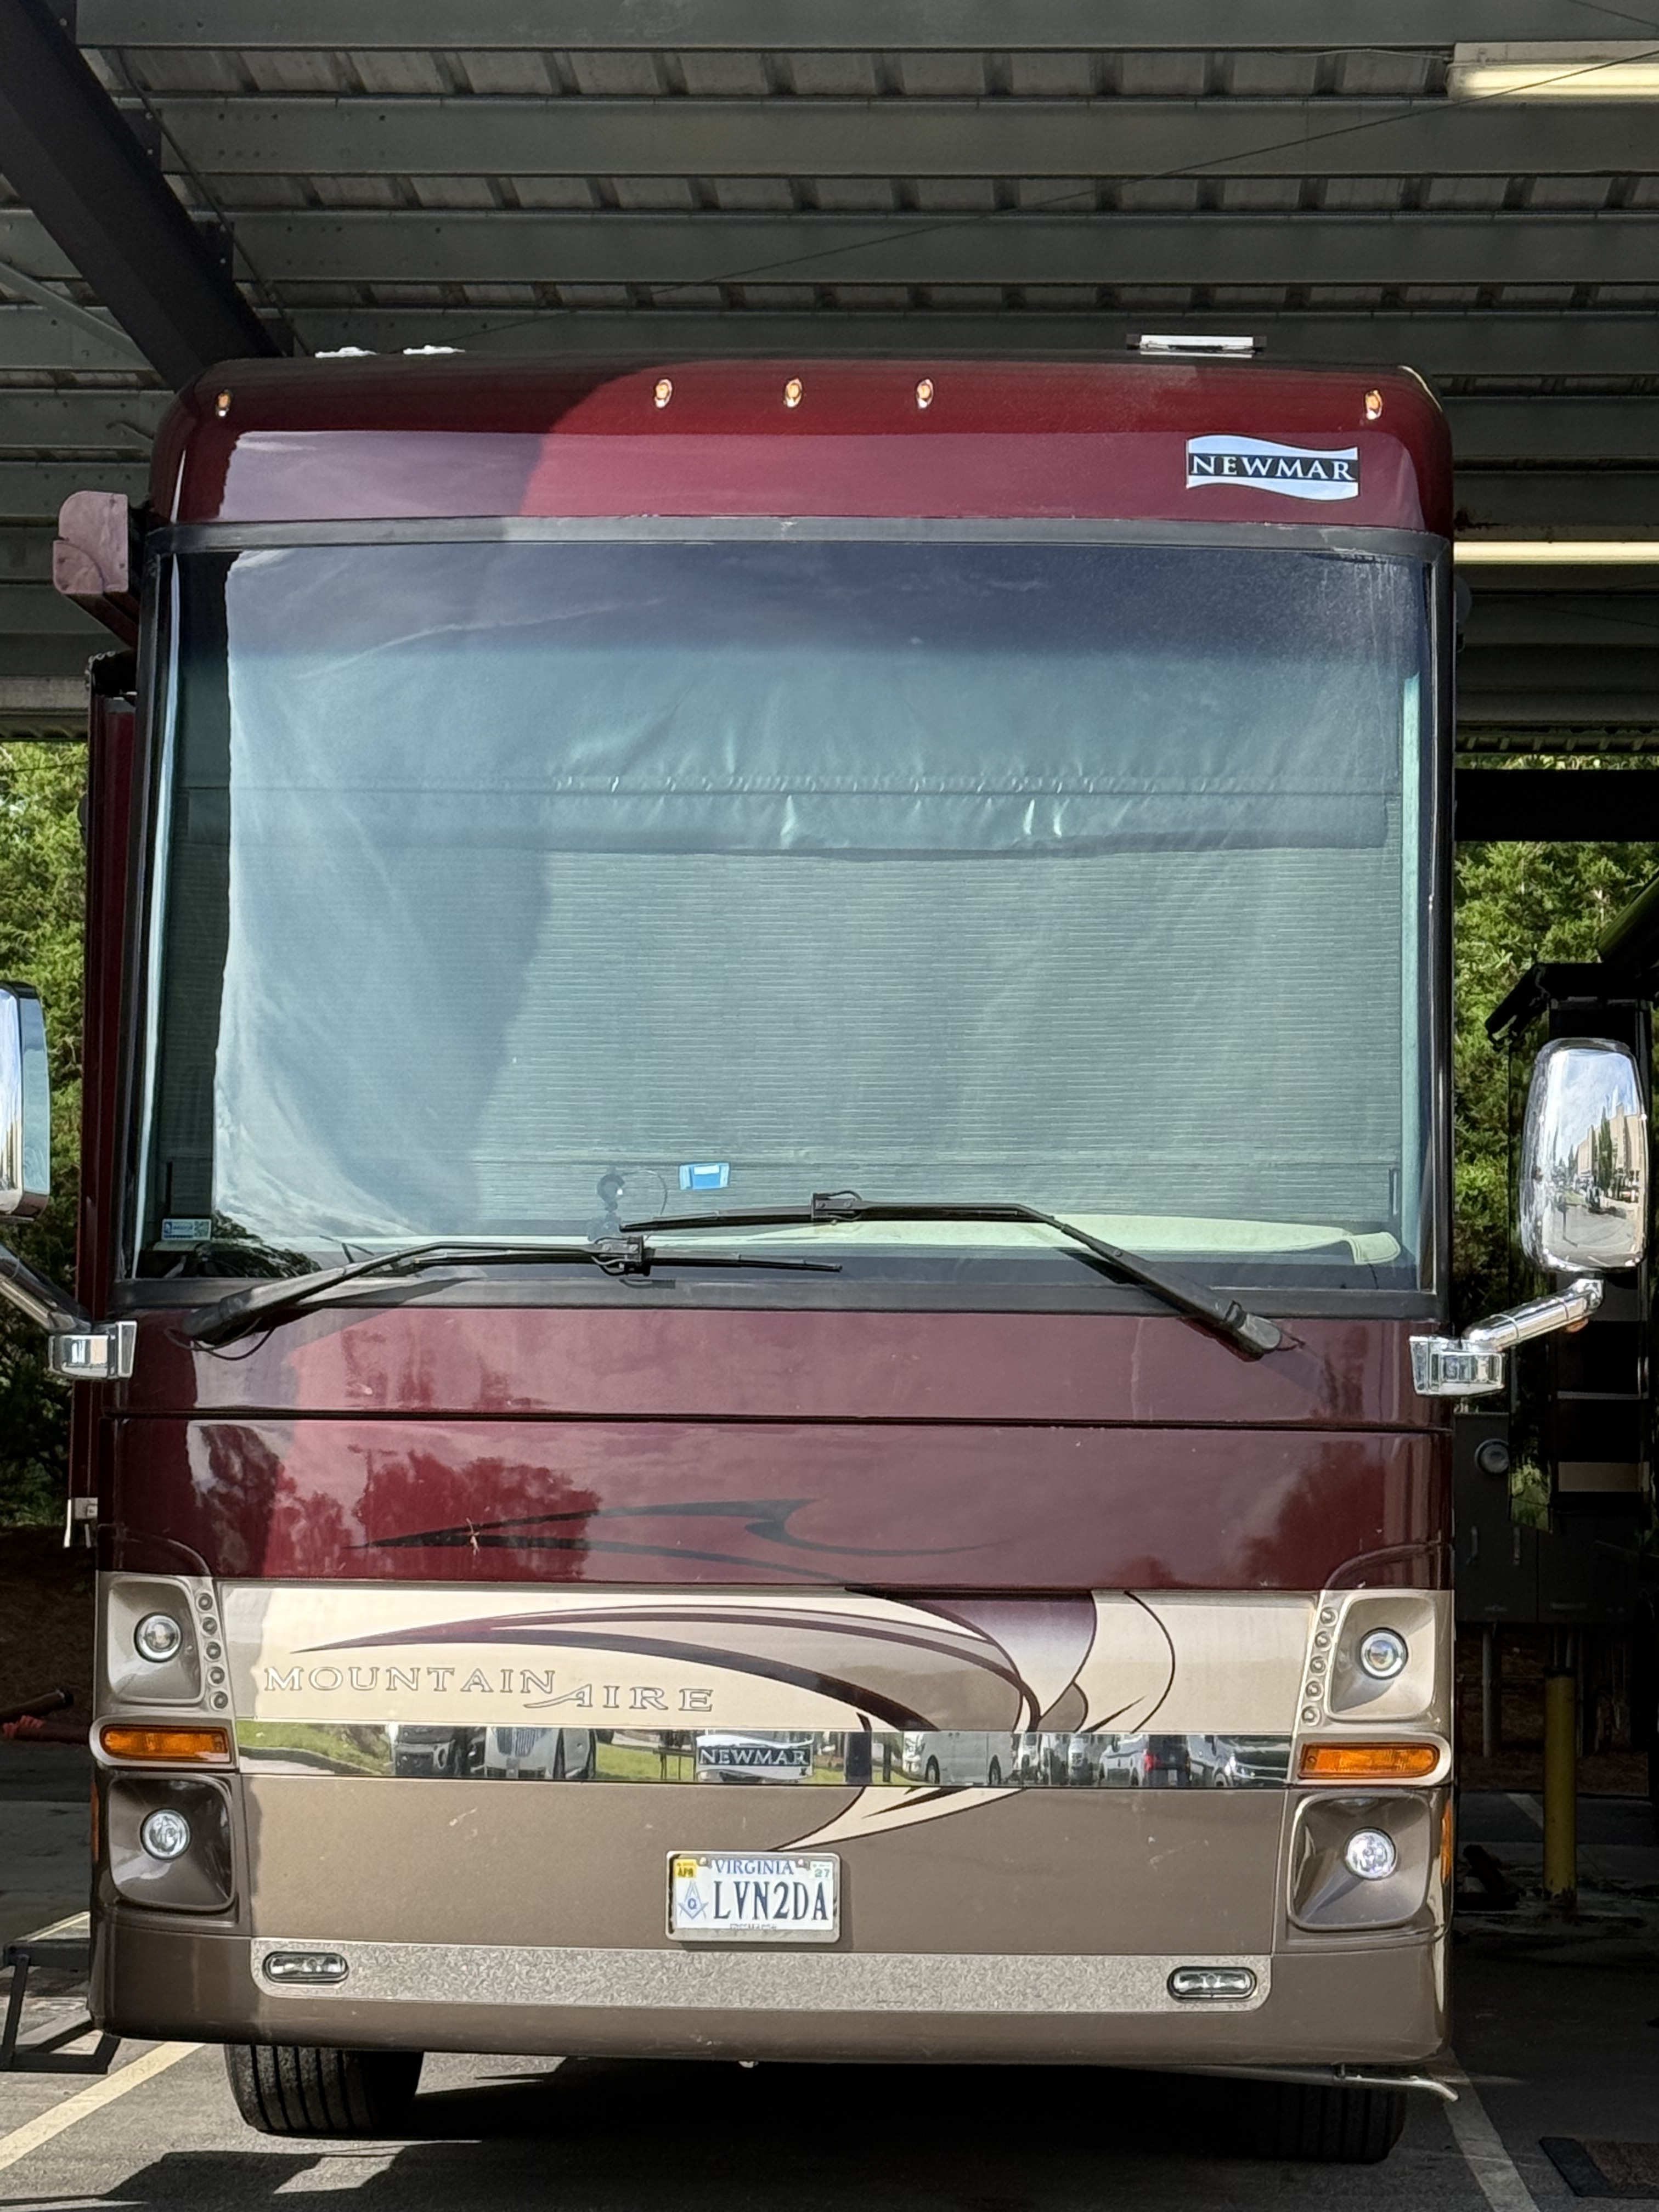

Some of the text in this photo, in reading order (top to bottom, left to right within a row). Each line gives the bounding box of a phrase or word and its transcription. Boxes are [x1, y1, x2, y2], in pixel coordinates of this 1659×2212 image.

[1191, 455, 1357, 481] NEWMAR
[264, 1666, 714, 1712] MOUNTAIN AIRE
[698, 1748, 809, 1765] NEWMAR
[715, 1859, 794, 1875] VIRGINIA
[814, 1868, 830, 1878] 27
[714, 1881, 828, 1920] LVN2DA
